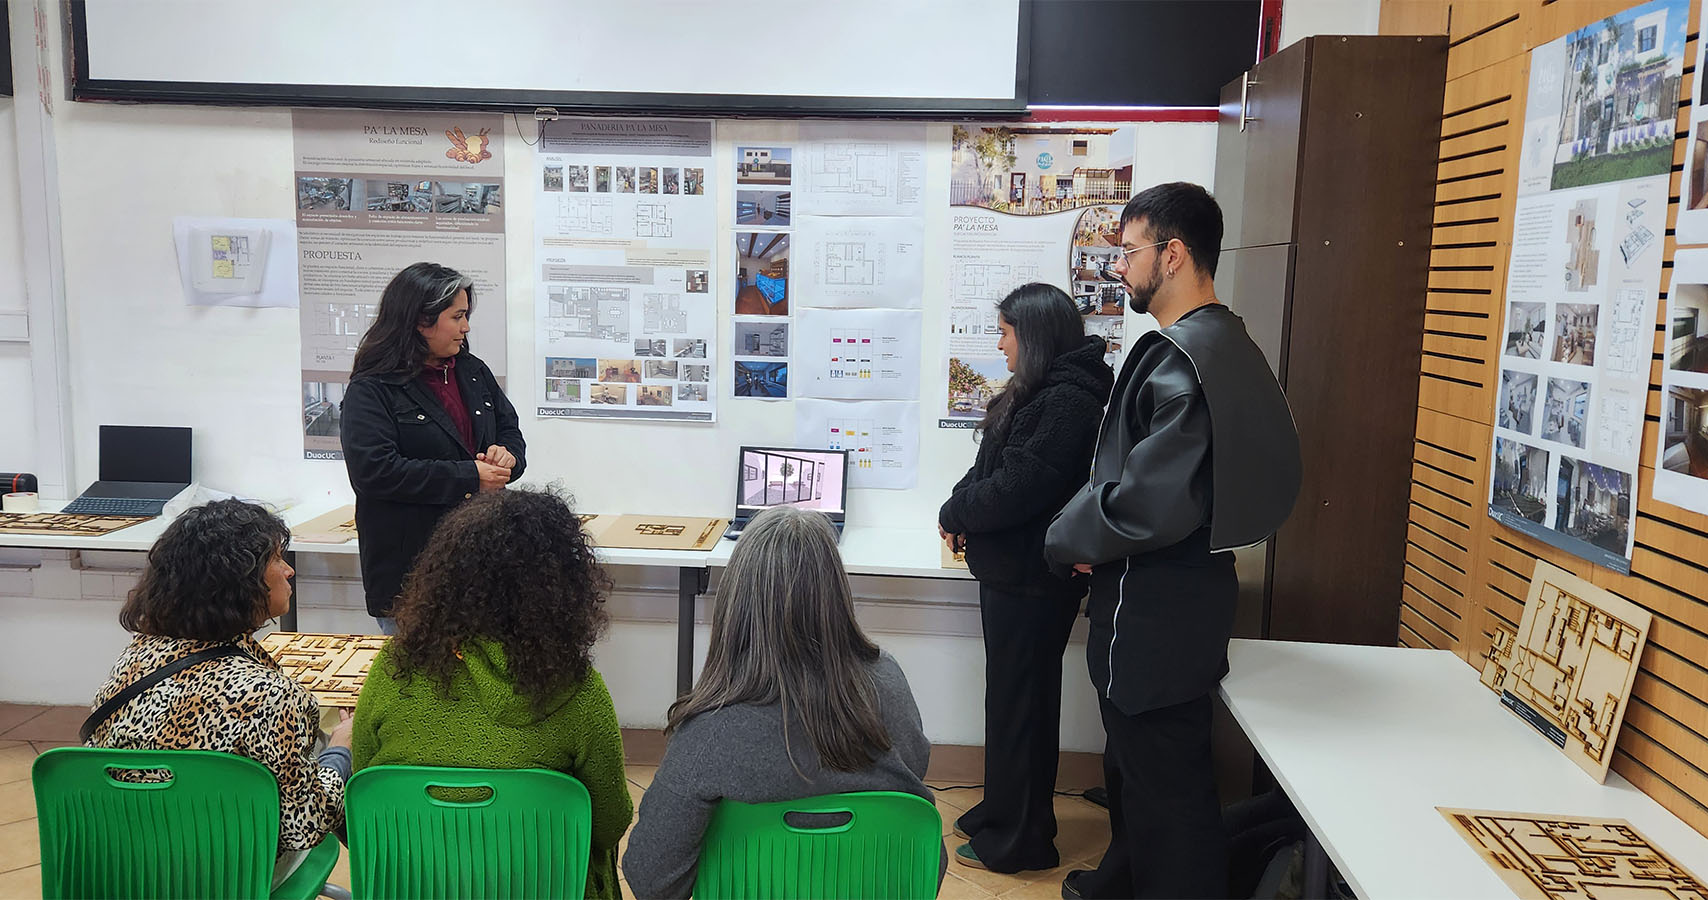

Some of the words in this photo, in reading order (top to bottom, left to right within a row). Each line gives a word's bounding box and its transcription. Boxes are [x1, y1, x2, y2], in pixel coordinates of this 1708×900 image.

[383, 126, 397, 135] LA
[400, 126, 428, 136] MESA
[953, 216, 995, 224] PROYECTO
[303, 250, 362, 260] PROPUESTA
